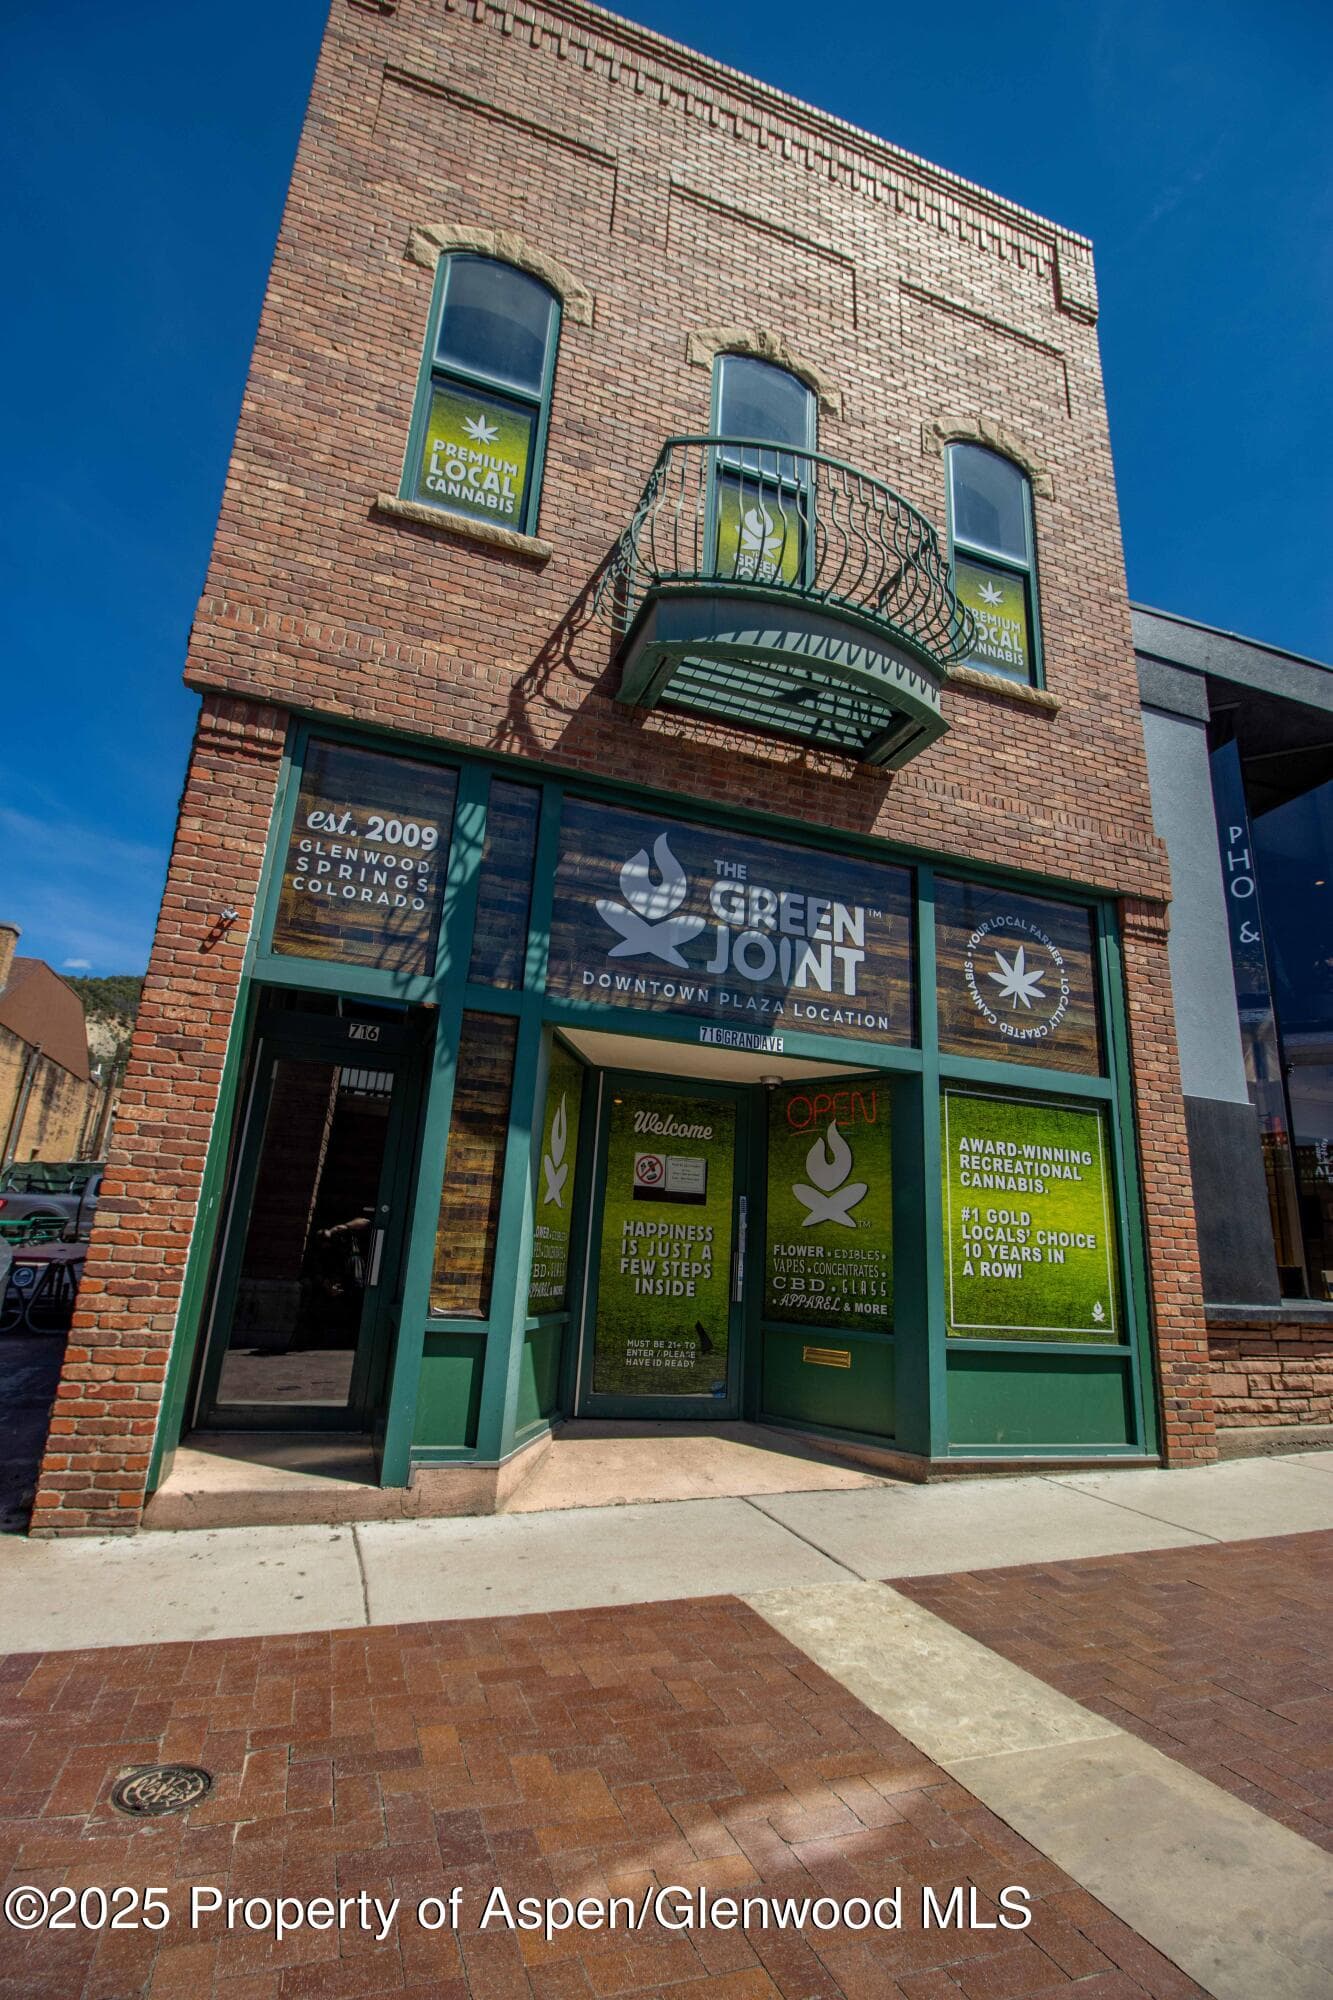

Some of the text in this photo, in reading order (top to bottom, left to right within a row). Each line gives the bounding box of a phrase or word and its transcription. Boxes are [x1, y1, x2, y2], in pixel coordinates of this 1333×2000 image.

[433, 439, 518, 477] PREMIUM
[429, 453, 515, 498] LOCAL
[426, 476, 514, 513] CANNABIS
[306, 810, 438, 851] est. 2009
[300, 839, 430, 874] GLENWOOD
[296, 857, 428, 893] SPRINGS
[713, 859, 747, 880] THE
[292, 877, 425, 910] COLORADO
[709, 880, 865, 946] GREEN
[967, 916, 1063, 966] YOUR LOCAL FARMER
[1240, 921, 1260, 943] &
[706, 925, 865, 996] JOINT
[583, 970, 889, 1030] DOWNTOWN PLAZA LOCATION
[964, 961, 1069, 1039] LOCALLY CRAFTED CANNABIS
[350, 1024, 379, 1040] 716
[702, 1027, 782, 1052] 716 GRAND AVE
[787, 1088, 877, 1129] OPEN
[633, 1110, 714, 1140] Welcome
[959, 1137, 1092, 1166] AWARD-WINNING
[960, 1154, 1082, 1181] RECREATIONAL
[960, 1172, 1049, 1194] CANNABIS.
[961, 1207, 1030, 1226] #1 GOLD
[623, 1220, 713, 1241] HAPPINESS
[1037, 1231, 1096, 1249] CHOICE
[622, 1240, 712, 1260] IS JUST A
[773, 1244, 880, 1261] FLOWER EDIBLES
[963, 1243, 1065, 1263] 10 YEARS IN
[620, 1258, 711, 1279] FEW STEPS
[773, 1258, 879, 1278] VAPES CONCENTRATES
[962, 1261, 1023, 1279] A ROW!
[635, 1278, 695, 1297] INSIDE
[772, 1276, 887, 1297] CBD GLASS
[779, 1293, 888, 1315] APPAREL & MORE
[626, 1339, 650, 1348] MUST
[653, 1340, 665, 1348] BE
[684, 1341, 696, 1349] TO
[626, 1349, 654, 1357] ENTER
[625, 1358, 696, 1368] HAVE ID READY
